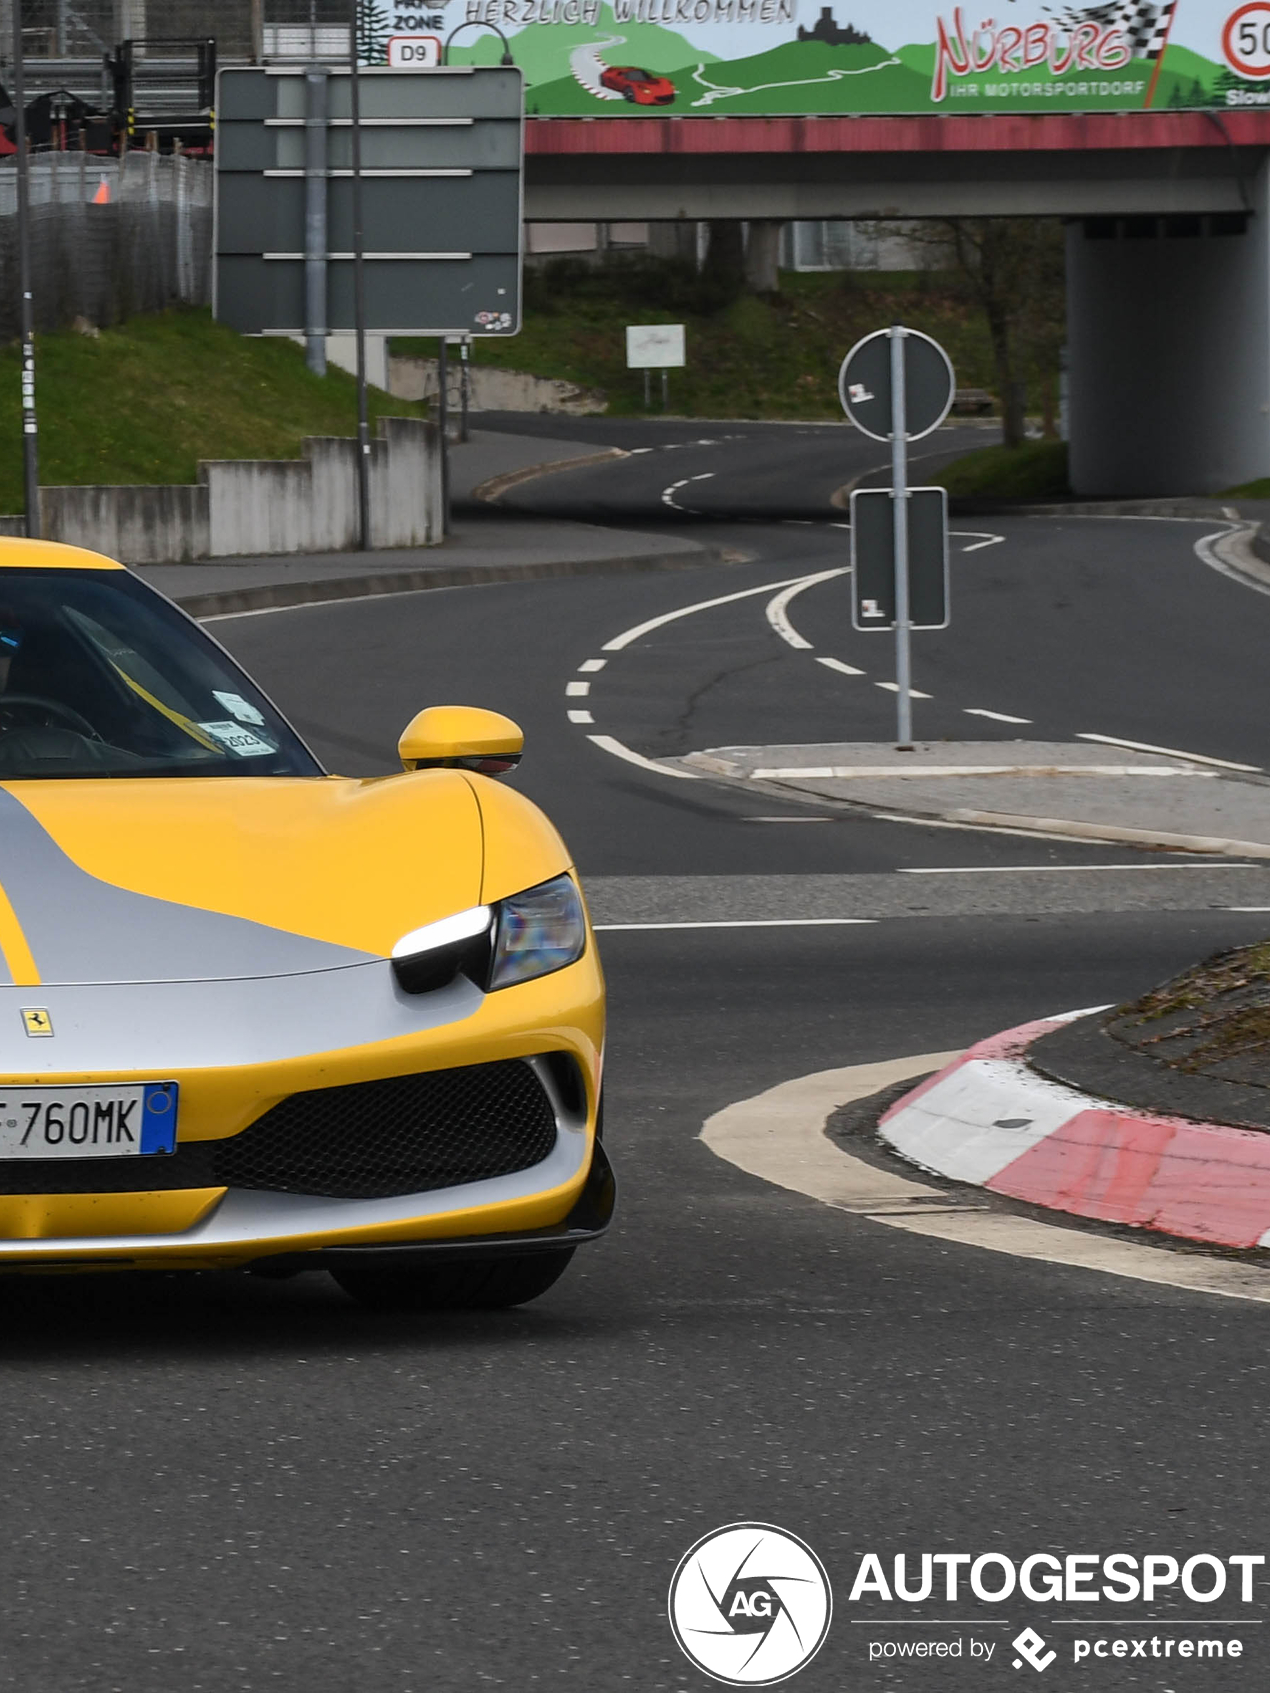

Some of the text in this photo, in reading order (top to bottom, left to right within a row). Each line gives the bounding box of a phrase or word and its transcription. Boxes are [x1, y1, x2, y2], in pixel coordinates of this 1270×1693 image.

[465, 0, 796, 25] HERZLICH WILLKOMMEN
[393, 15, 444, 30] ZONE
[400, 45, 427, 61] D9
[931, 5, 1132, 102] NÜRBURG
[949, 80, 1145, 97] IHR MOTORSPORTDORF
[1225, 88, 1270, 105] Slow
[224, 734, 261, 748] 2023
[20, 1099, 138, 1146] 760MK
